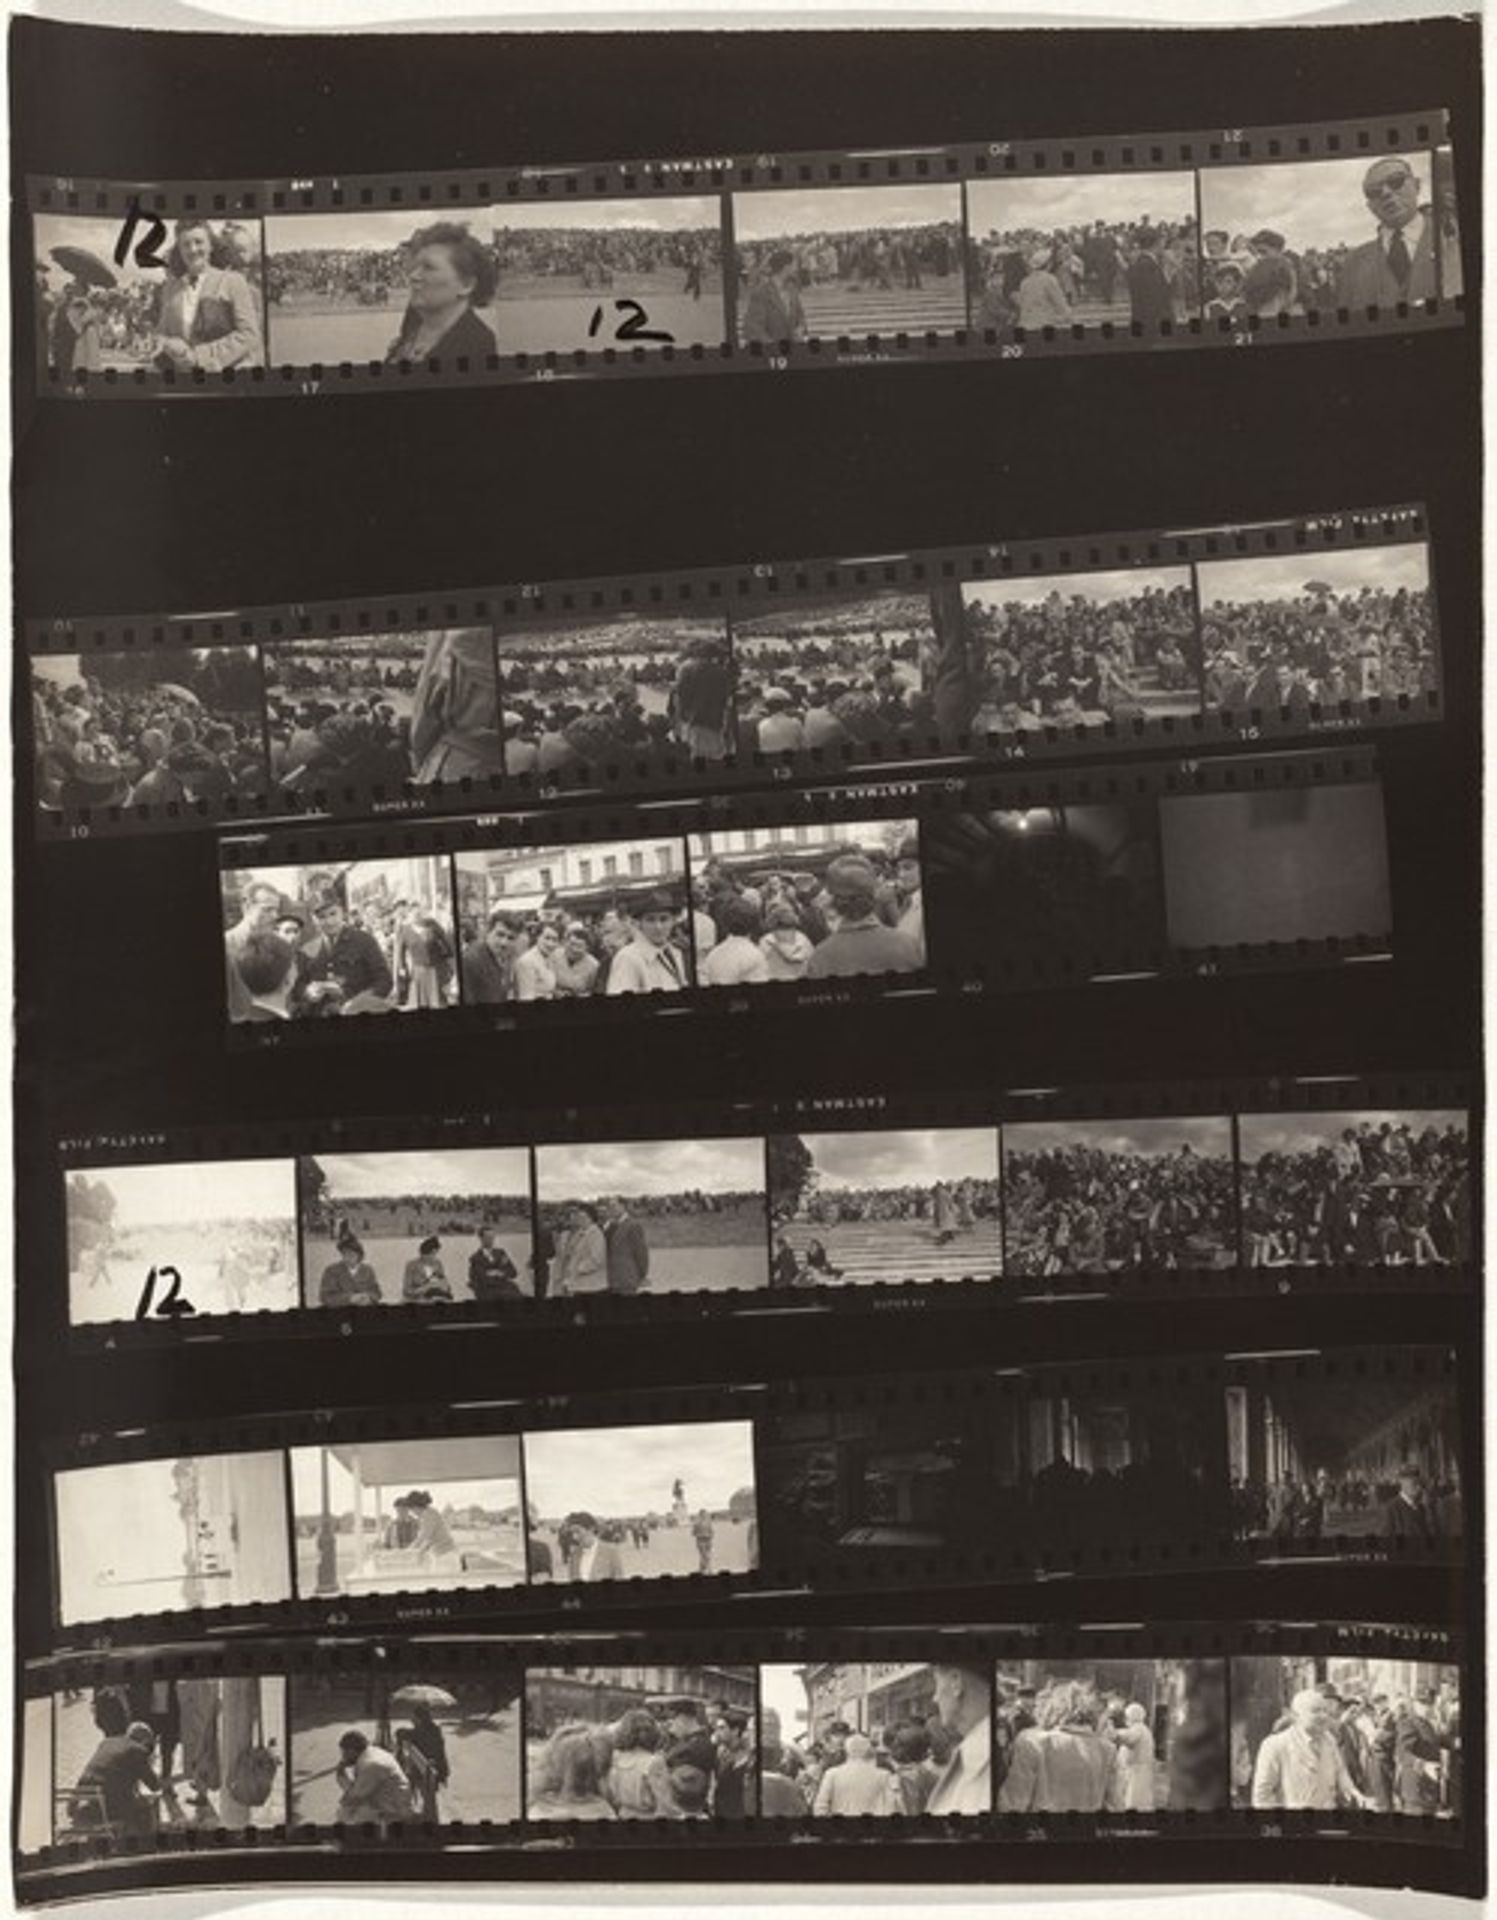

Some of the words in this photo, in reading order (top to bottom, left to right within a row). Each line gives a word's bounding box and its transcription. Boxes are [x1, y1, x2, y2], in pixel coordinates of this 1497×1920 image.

[587, 299, 676, 343] 12
[1233, 332, 1253, 345] 21
[1001, 344, 1023, 358] 20
[301, 380, 320, 395] 17
[70, 824, 90, 839] 10
[136, 1265, 197, 1321] 12
